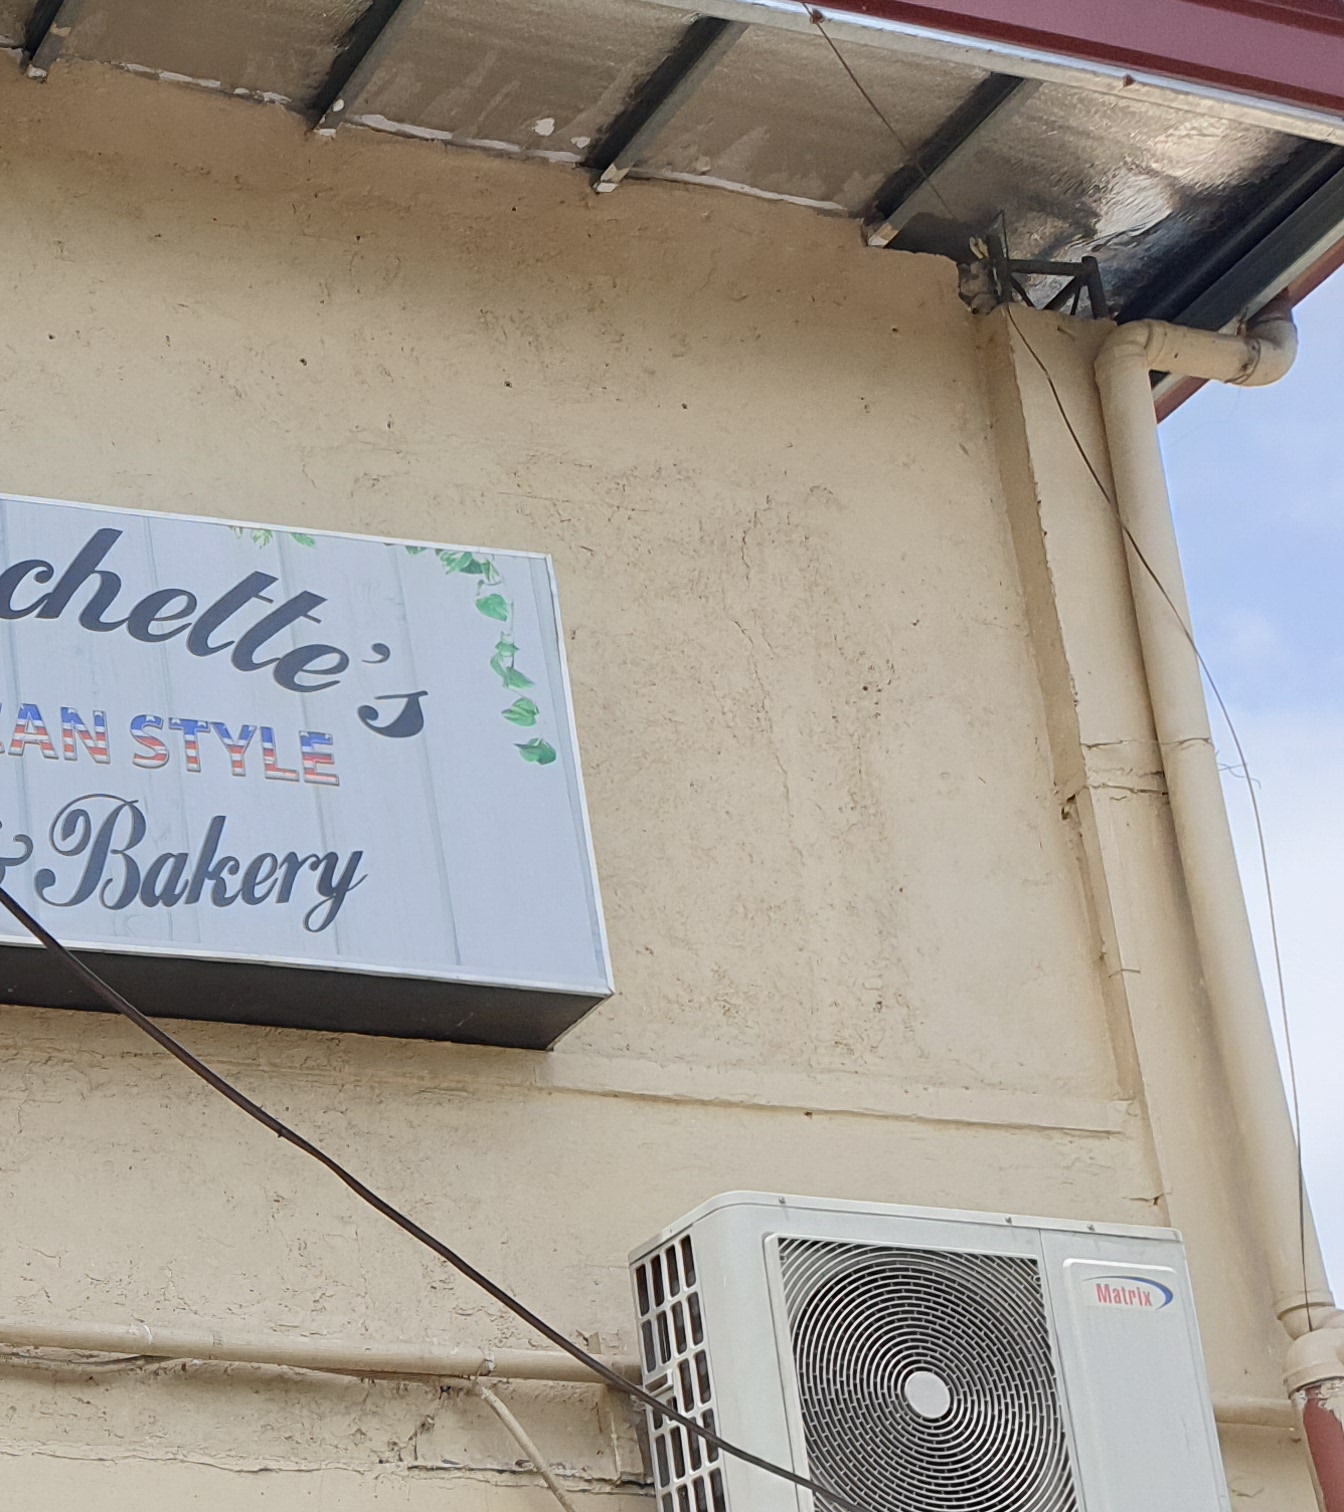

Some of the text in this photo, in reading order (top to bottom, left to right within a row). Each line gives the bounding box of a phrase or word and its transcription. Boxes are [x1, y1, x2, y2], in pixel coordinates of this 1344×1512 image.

[129, 713, 340, 787] STYLE
[34, 793, 368, 933] Bakery
[1095, 1283, 1153, 1307] Matrix
